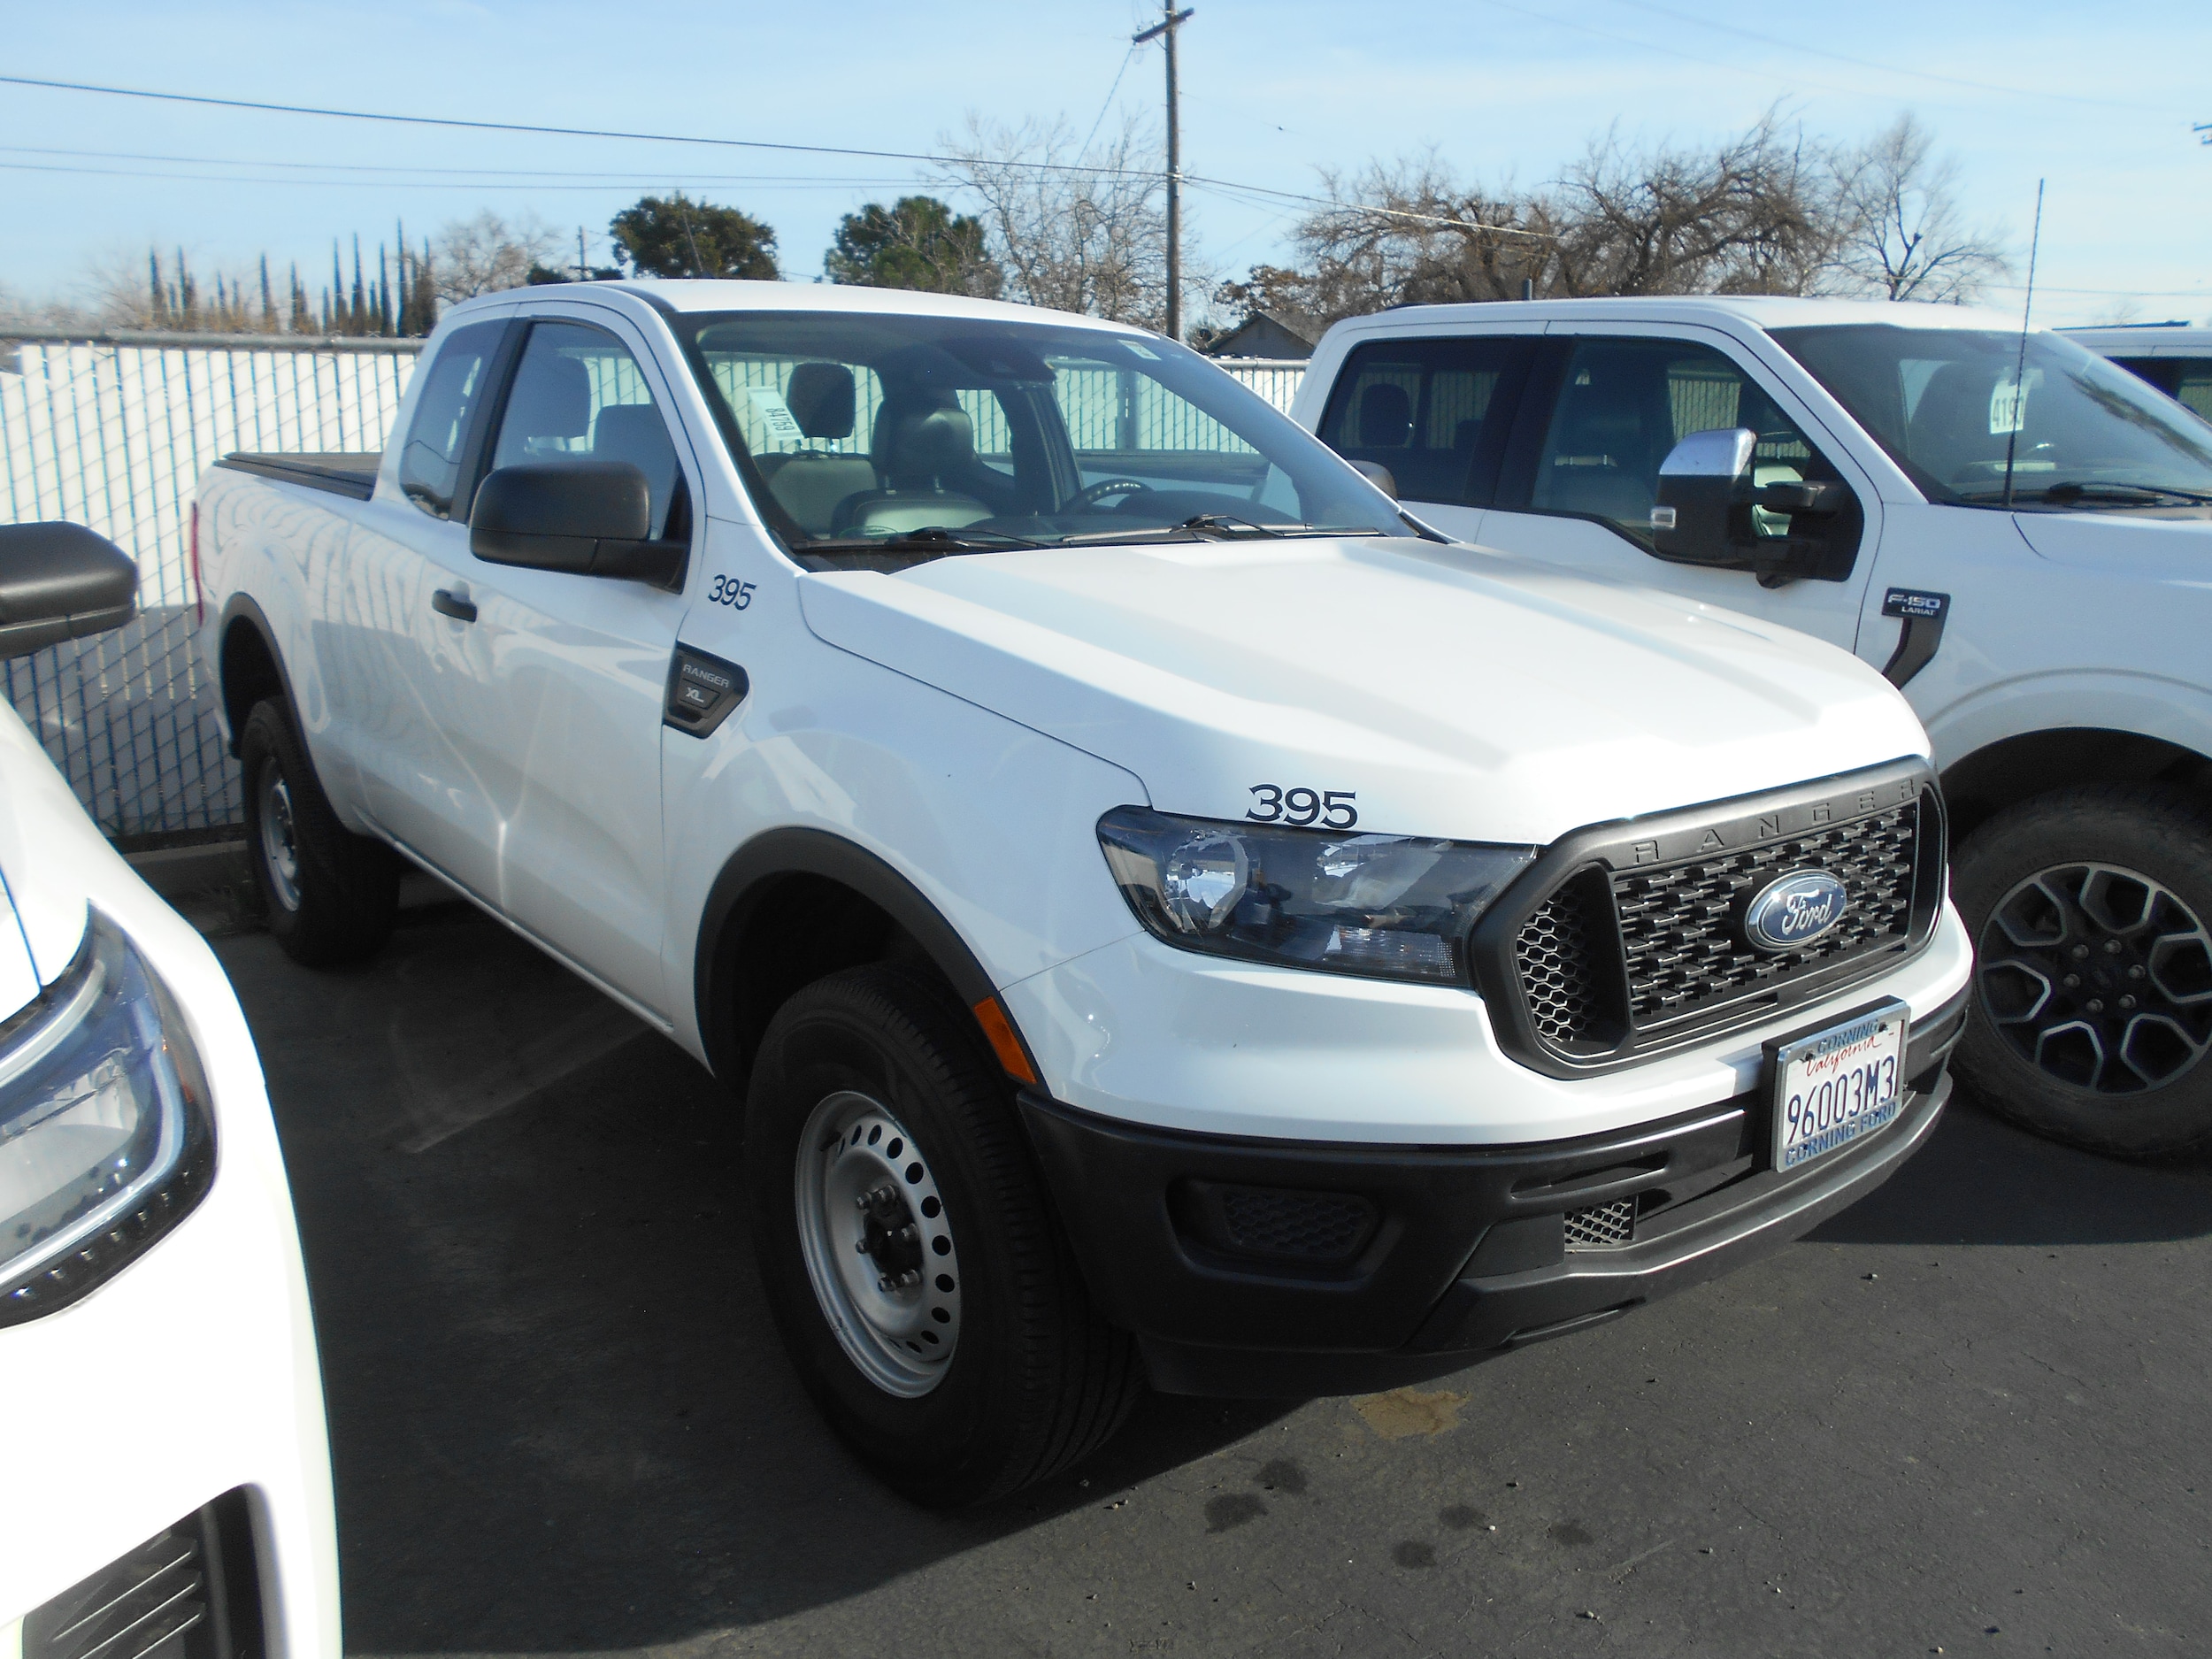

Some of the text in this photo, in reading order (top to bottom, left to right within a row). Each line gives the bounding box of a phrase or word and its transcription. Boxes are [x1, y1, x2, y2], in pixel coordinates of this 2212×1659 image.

[708, 573, 757, 611] 395
[1887, 594, 1941, 609] F-150
[1901, 606, 1935, 616] LARIAT
[683, 663, 730, 688] RANGER
[686, 687, 704, 703] XL
[1245, 783, 1358, 829] 395
[1631, 779, 1916, 864] RANGER
[1781, 888, 1832, 935] Ford
[1806, 1035, 1882, 1077] California
[1816, 1018, 1879, 1054] CORNING
[1787, 1055, 1895, 1146] 96003M3
[1786, 1102, 1896, 1167] CORNING FORD
